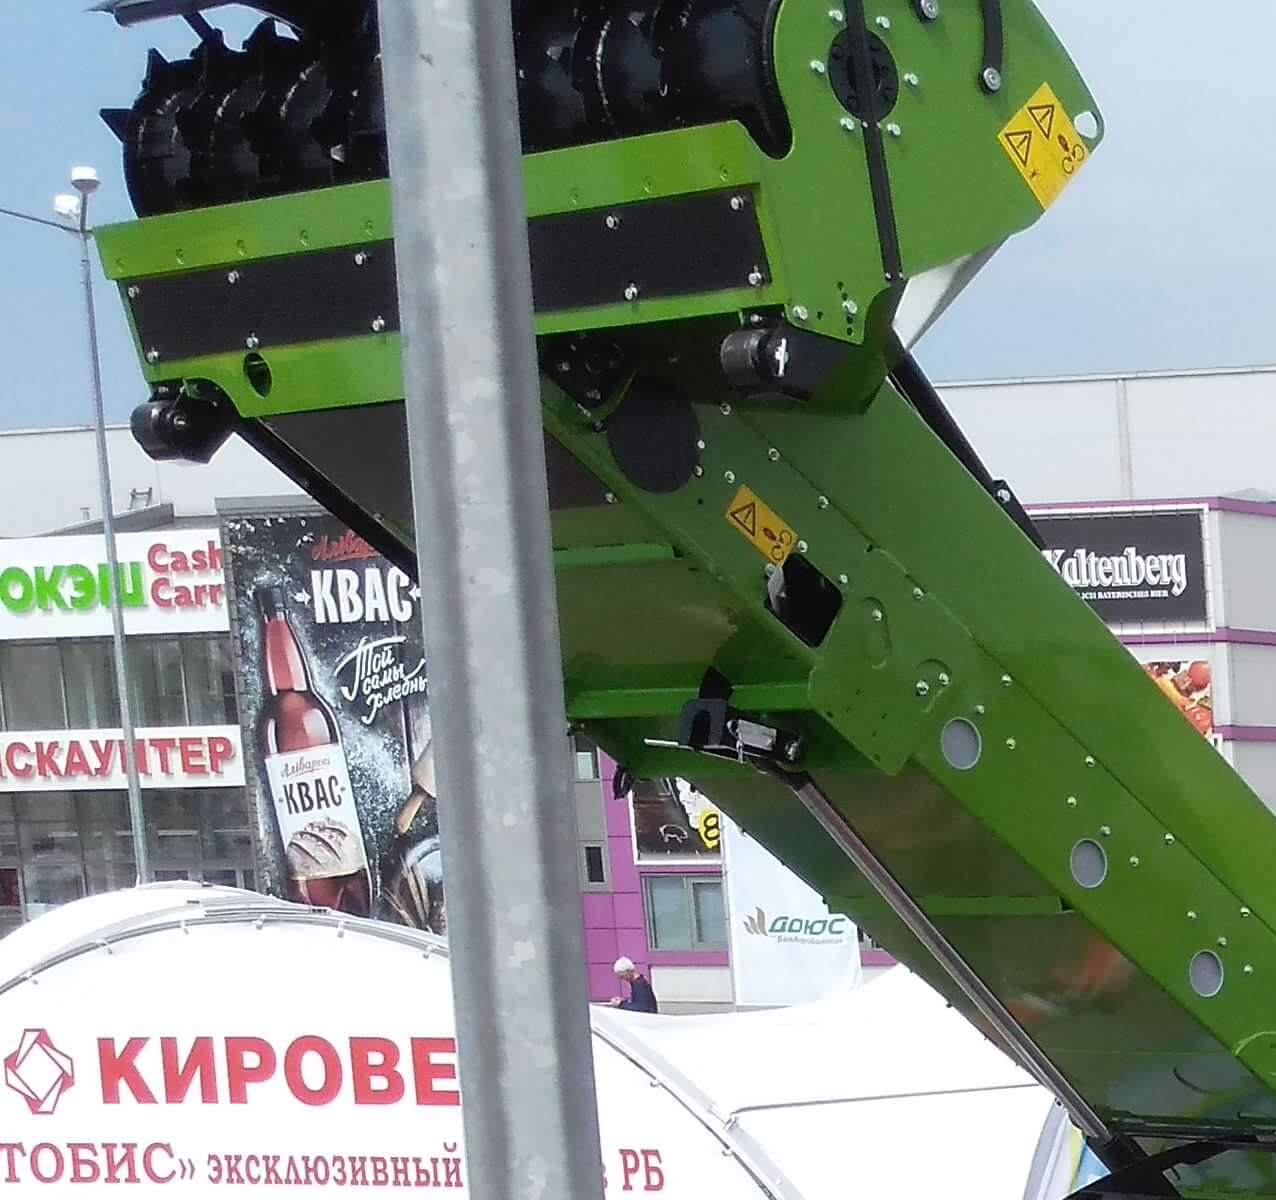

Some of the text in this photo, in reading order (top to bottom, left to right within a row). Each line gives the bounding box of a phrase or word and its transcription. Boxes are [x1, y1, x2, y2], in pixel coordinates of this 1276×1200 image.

[150, 577, 223, 608] Carr
[311, 567, 412, 624] КВАС
[282, 775, 343, 815] КВАС
[96, 1034, 461, 1106] КИРОВЕ
[206, 1142, 465, 1188] ЭКСКЛЮЗИВНЫЙ
[618, 1148, 664, 1192] РБ
